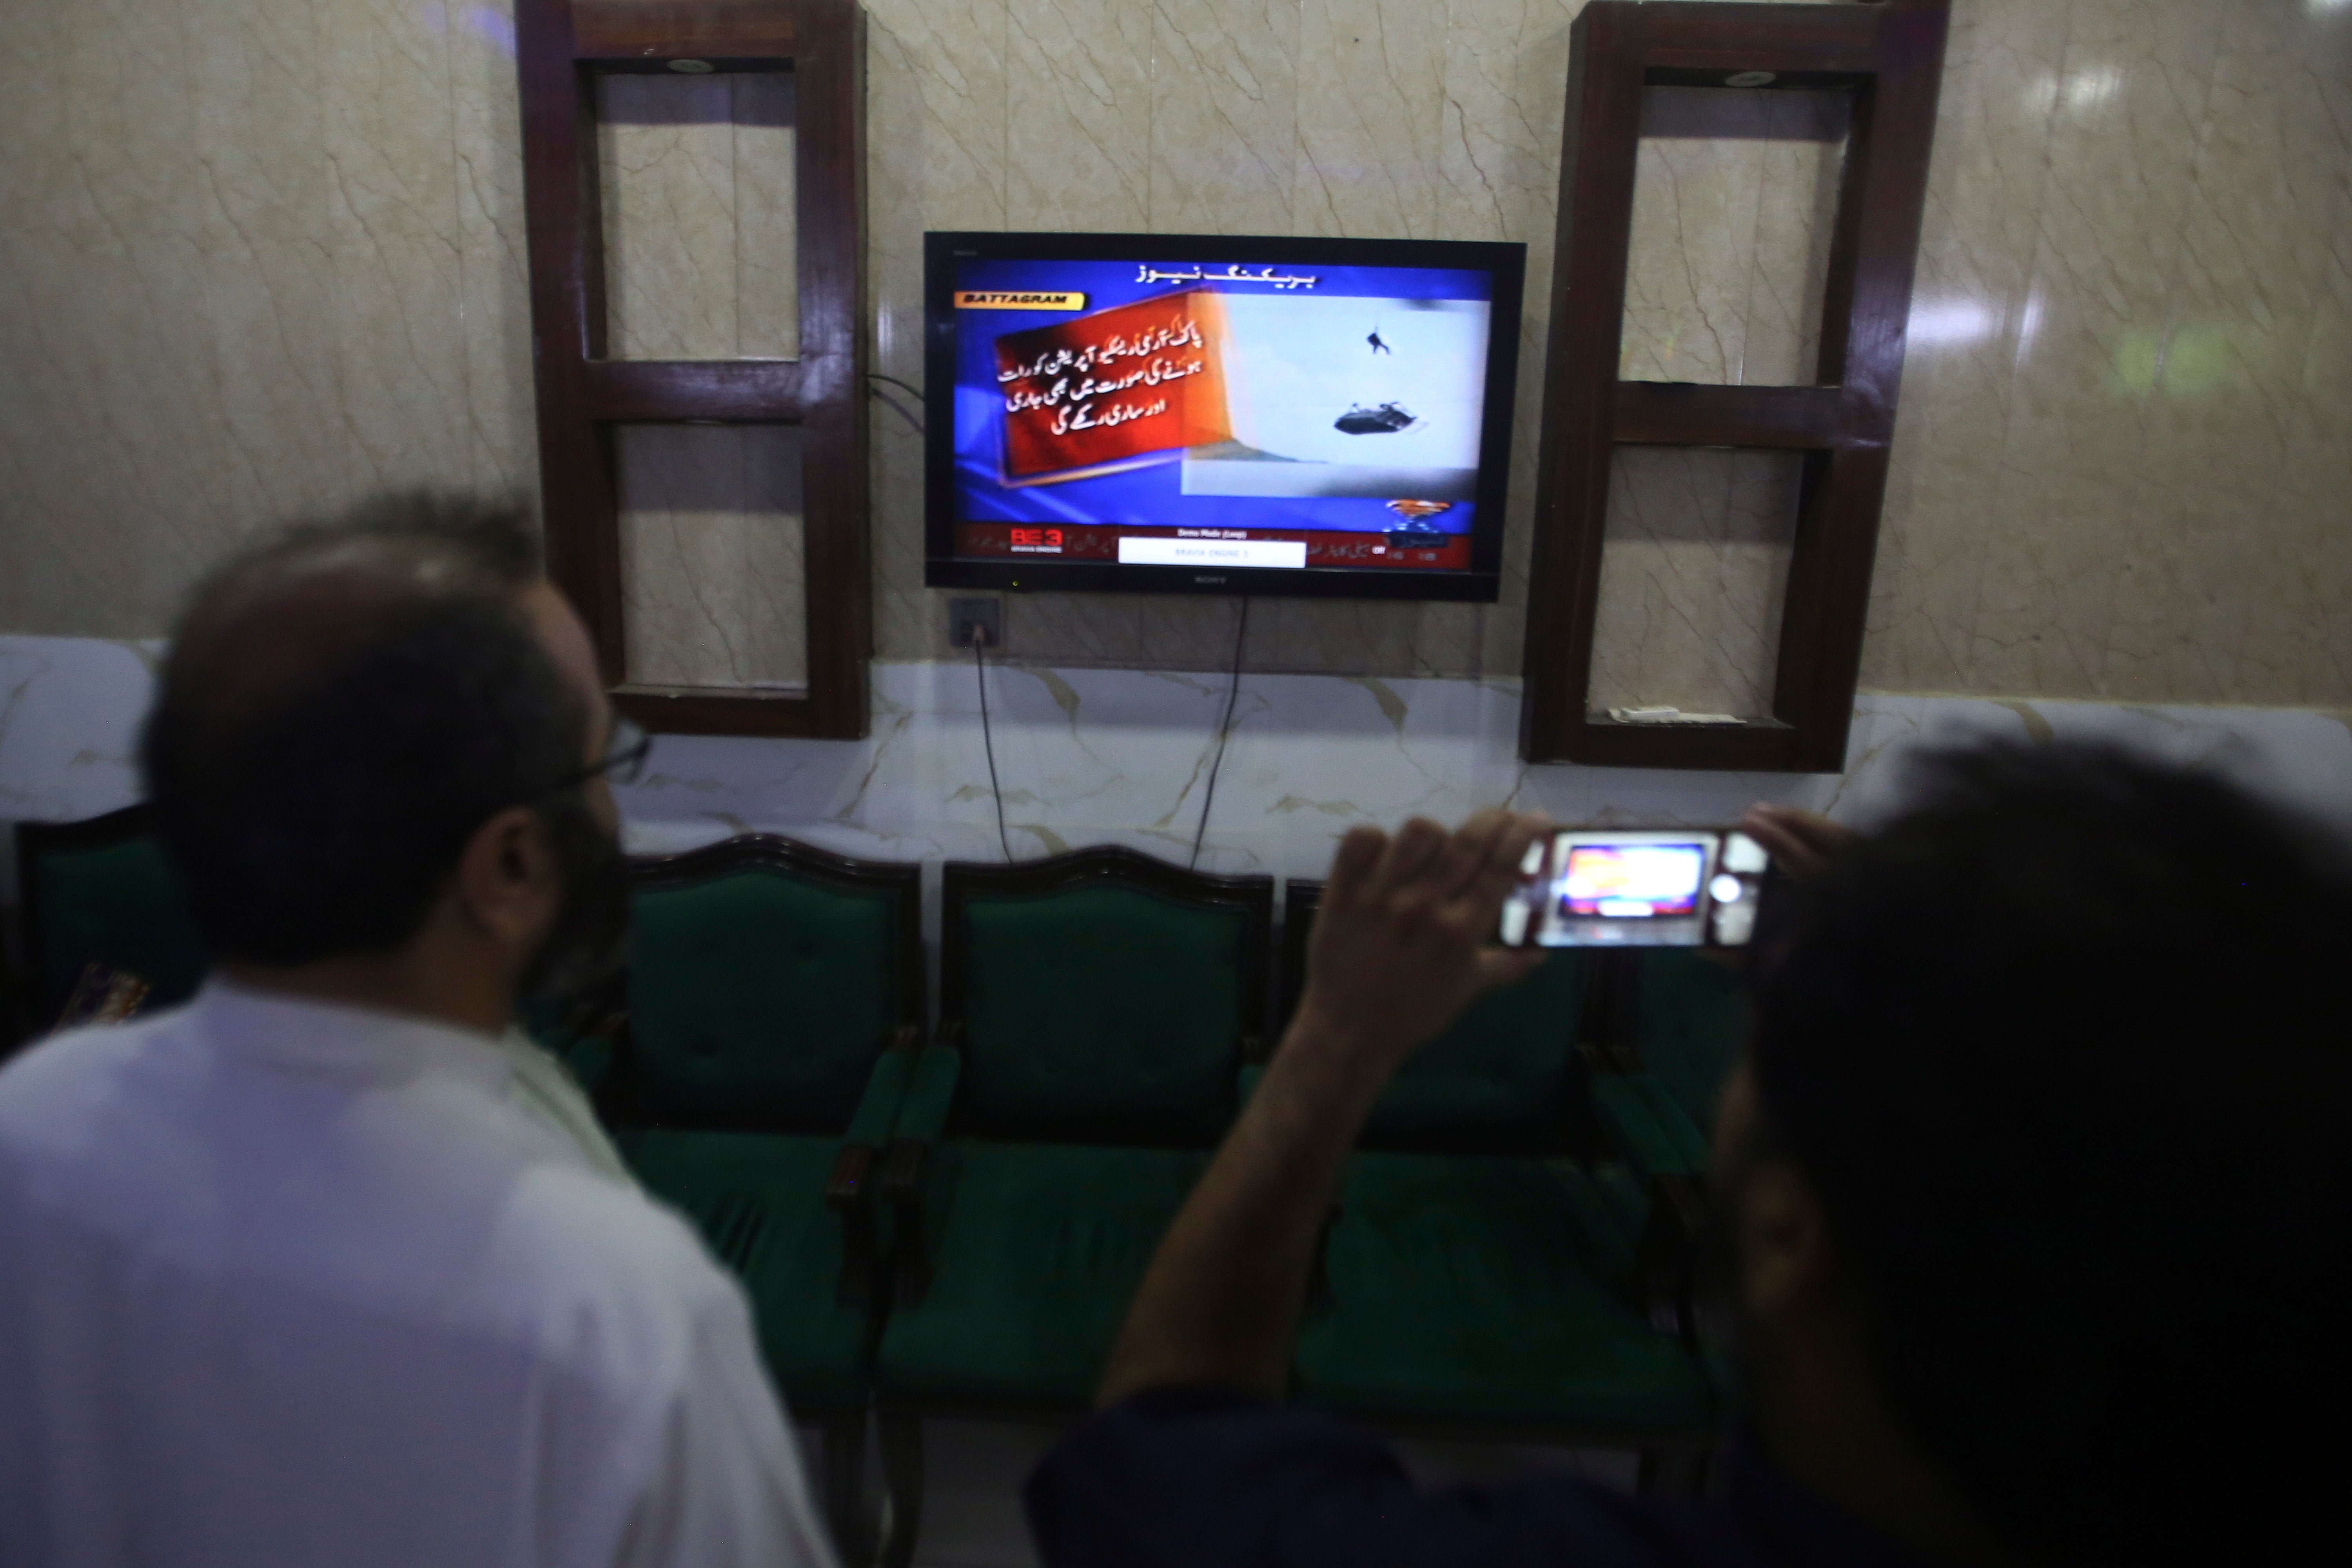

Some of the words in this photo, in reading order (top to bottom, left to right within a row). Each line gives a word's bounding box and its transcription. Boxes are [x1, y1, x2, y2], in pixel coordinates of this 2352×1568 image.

[1136, 265, 1201, 284] نیوز
[1203, 265, 1316, 289] بریکنگ
[964, 294, 1067, 303] BATTAGRAM
[1169, 319, 1202, 348] پاک
[998, 365, 1032, 382] رات
[1032, 353, 1049, 374] کو
[1144, 357, 1163, 385] کی
[1162, 360, 1202, 379] ہونے
[1044, 377, 1069, 405] بھی
[1070, 378, 1094, 400] میں
[1095, 369, 1144, 393] صورت
[1005, 391, 1043, 412] جاری
[1145, 398, 1166, 416] اور
[1178, 528, 1200, 537] Demo
[1200, 528, 1221, 538] Mode
